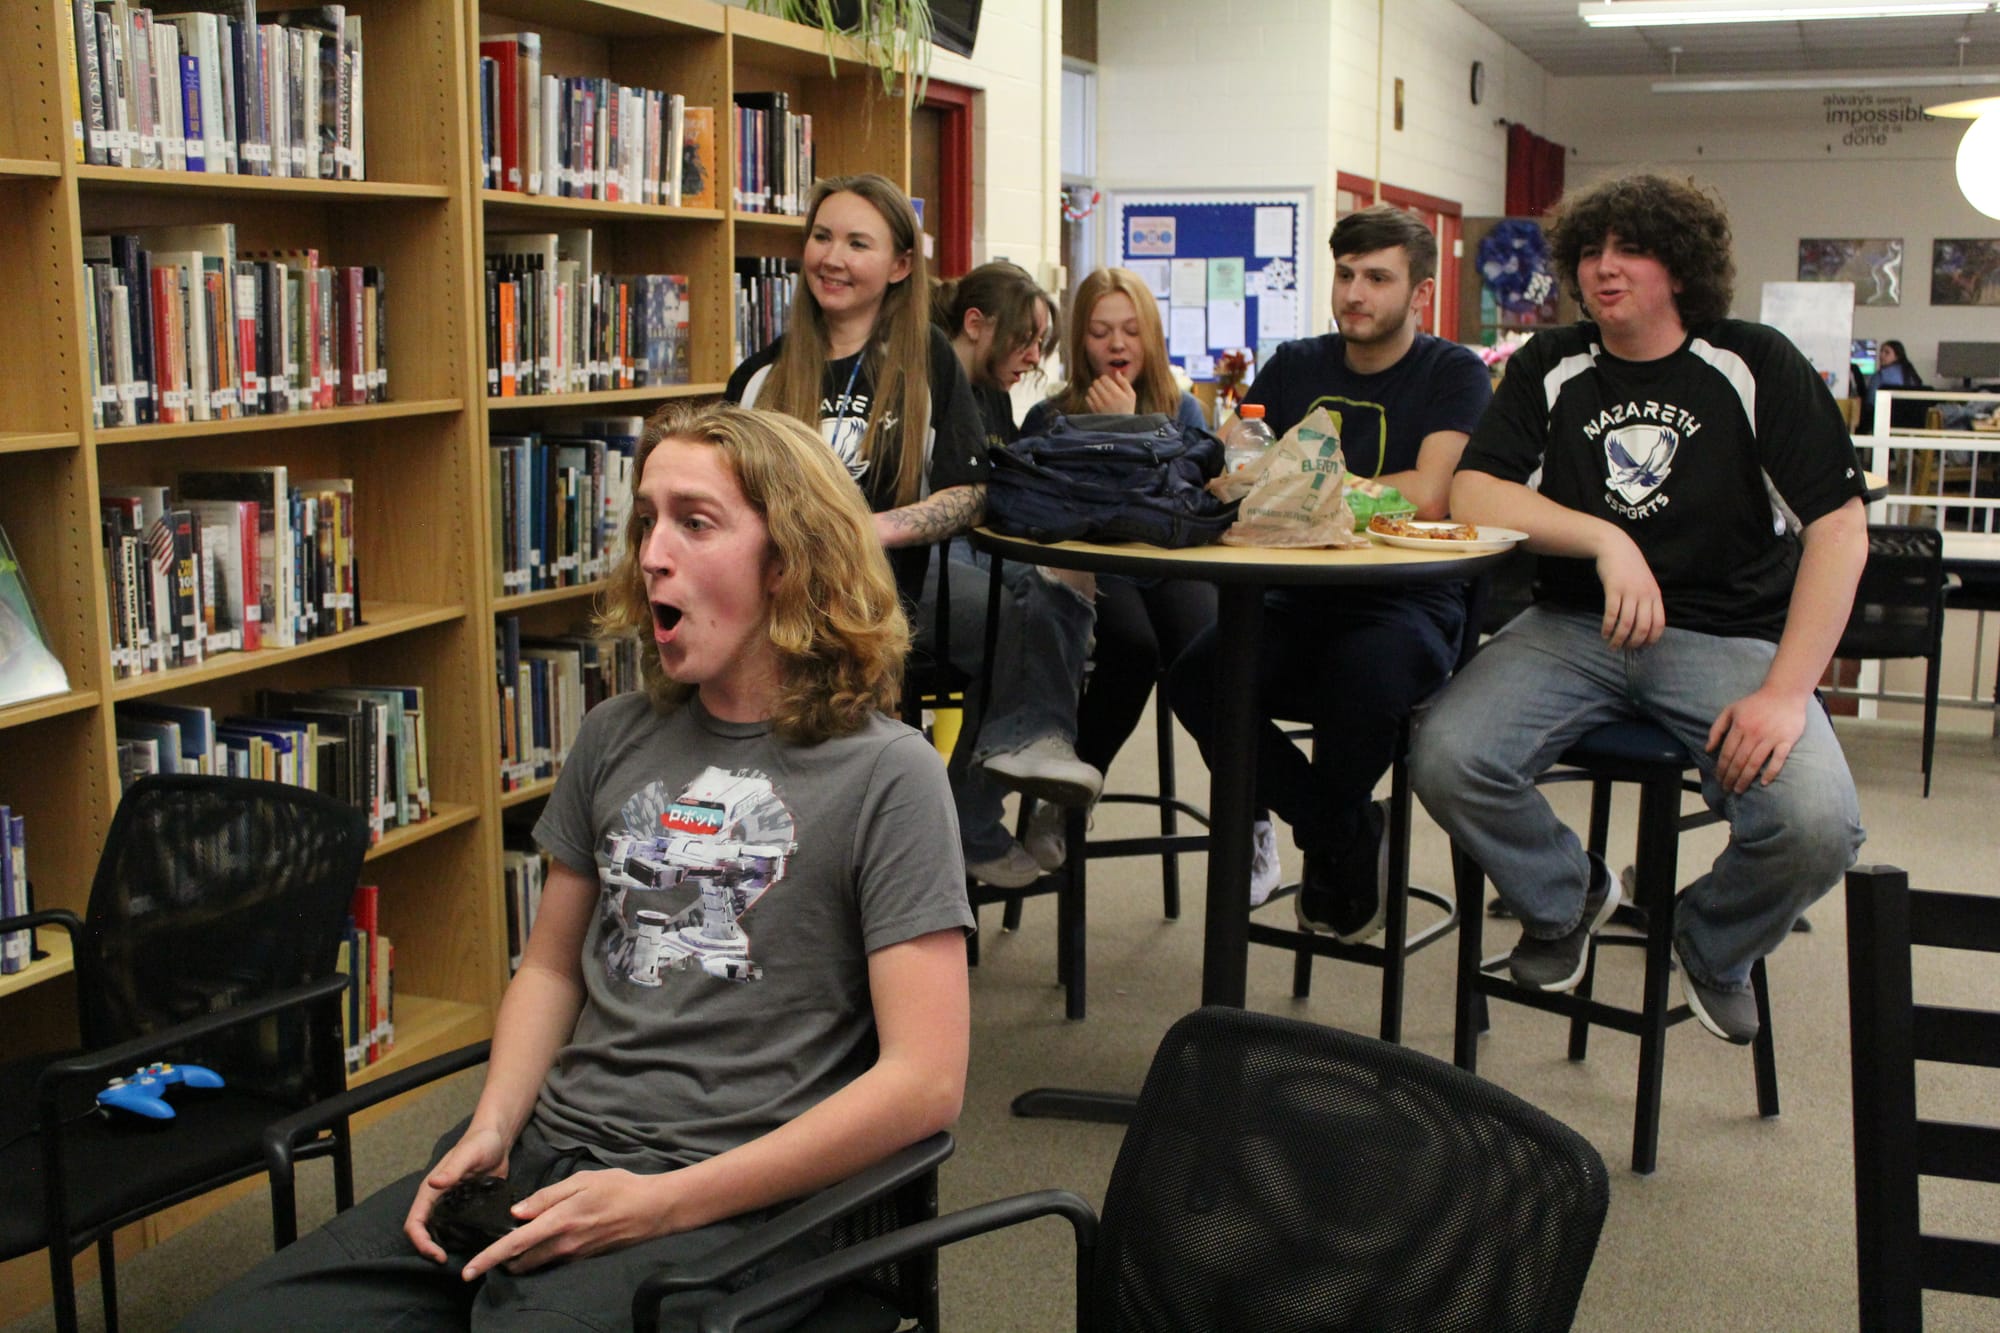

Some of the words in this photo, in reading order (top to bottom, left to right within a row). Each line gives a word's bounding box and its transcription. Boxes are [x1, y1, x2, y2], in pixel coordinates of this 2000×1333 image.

[1823, 93, 1873, 106] always
[1843, 131, 1887, 146] done
[1583, 401, 1701, 440] NAZARETH
[668, 809, 717, 827] ロボット
